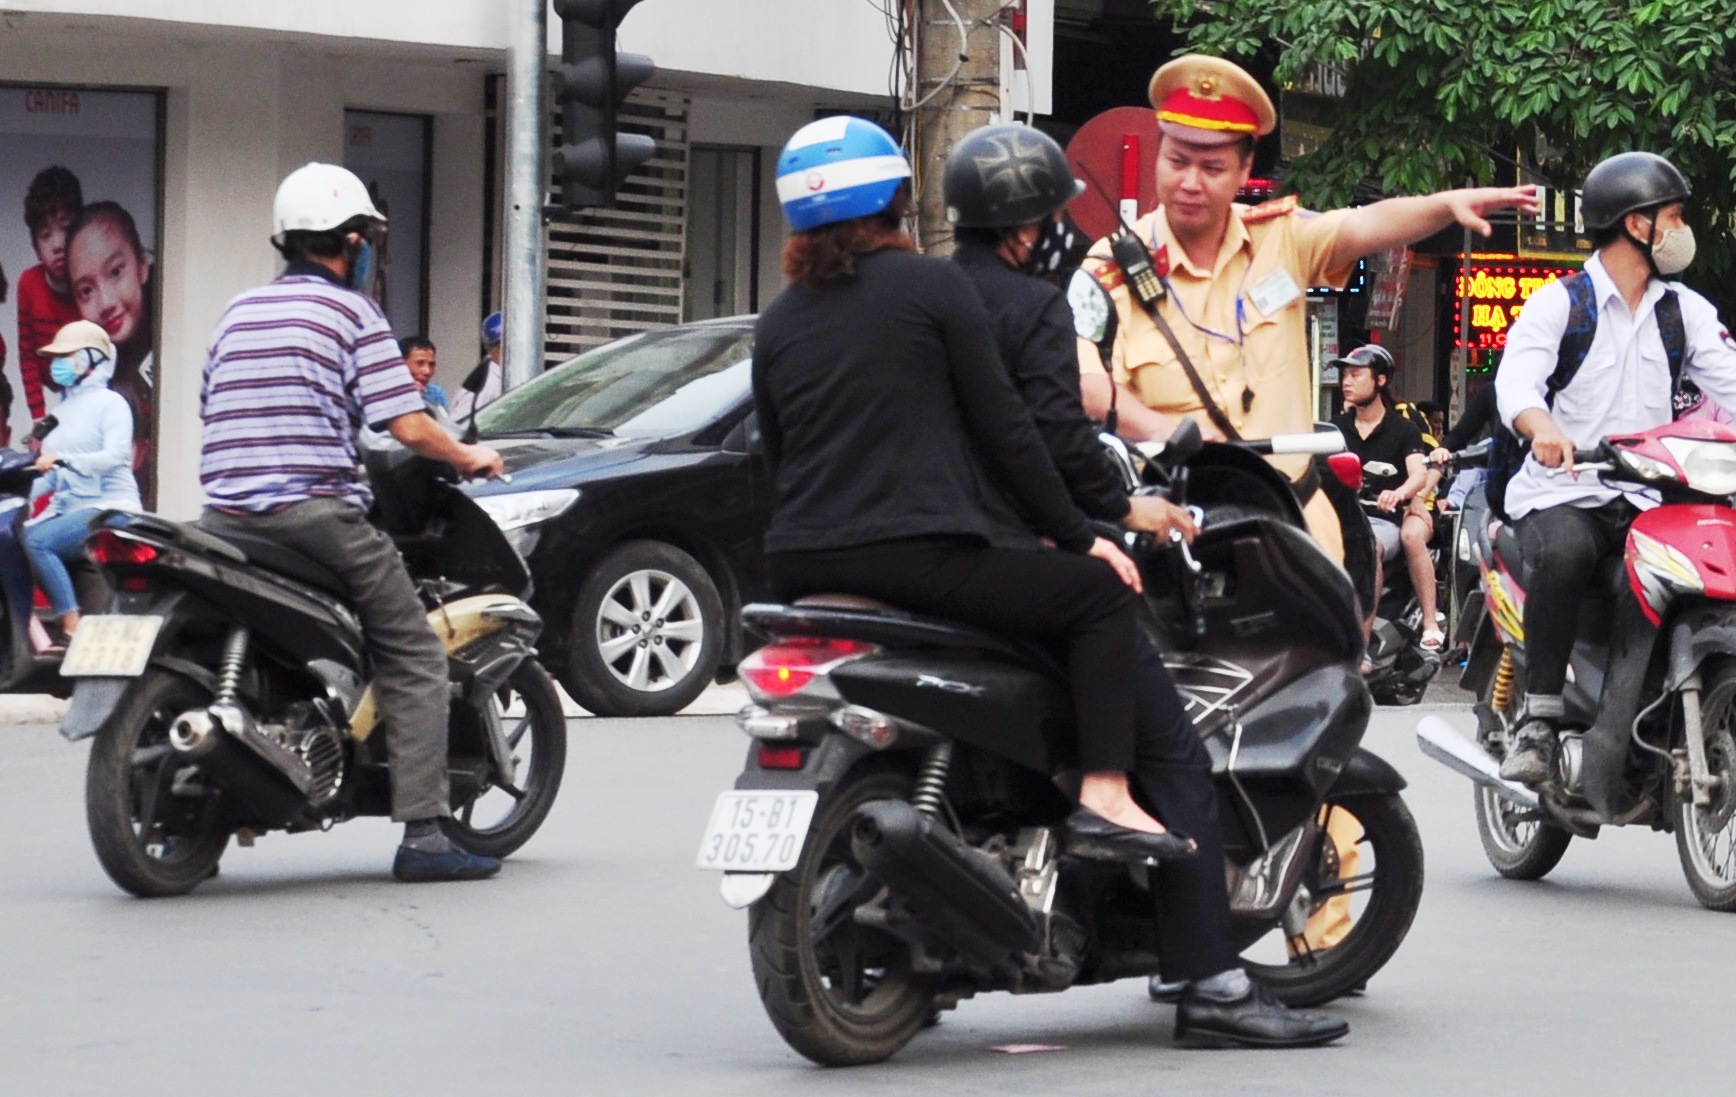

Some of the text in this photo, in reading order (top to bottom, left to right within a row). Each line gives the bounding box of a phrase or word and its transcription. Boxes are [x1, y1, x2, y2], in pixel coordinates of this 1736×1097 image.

[1472, 304, 1507, 332] HẠ
[730, 799, 798, 829] 15-B1
[705, 833, 797, 863] 305.70
